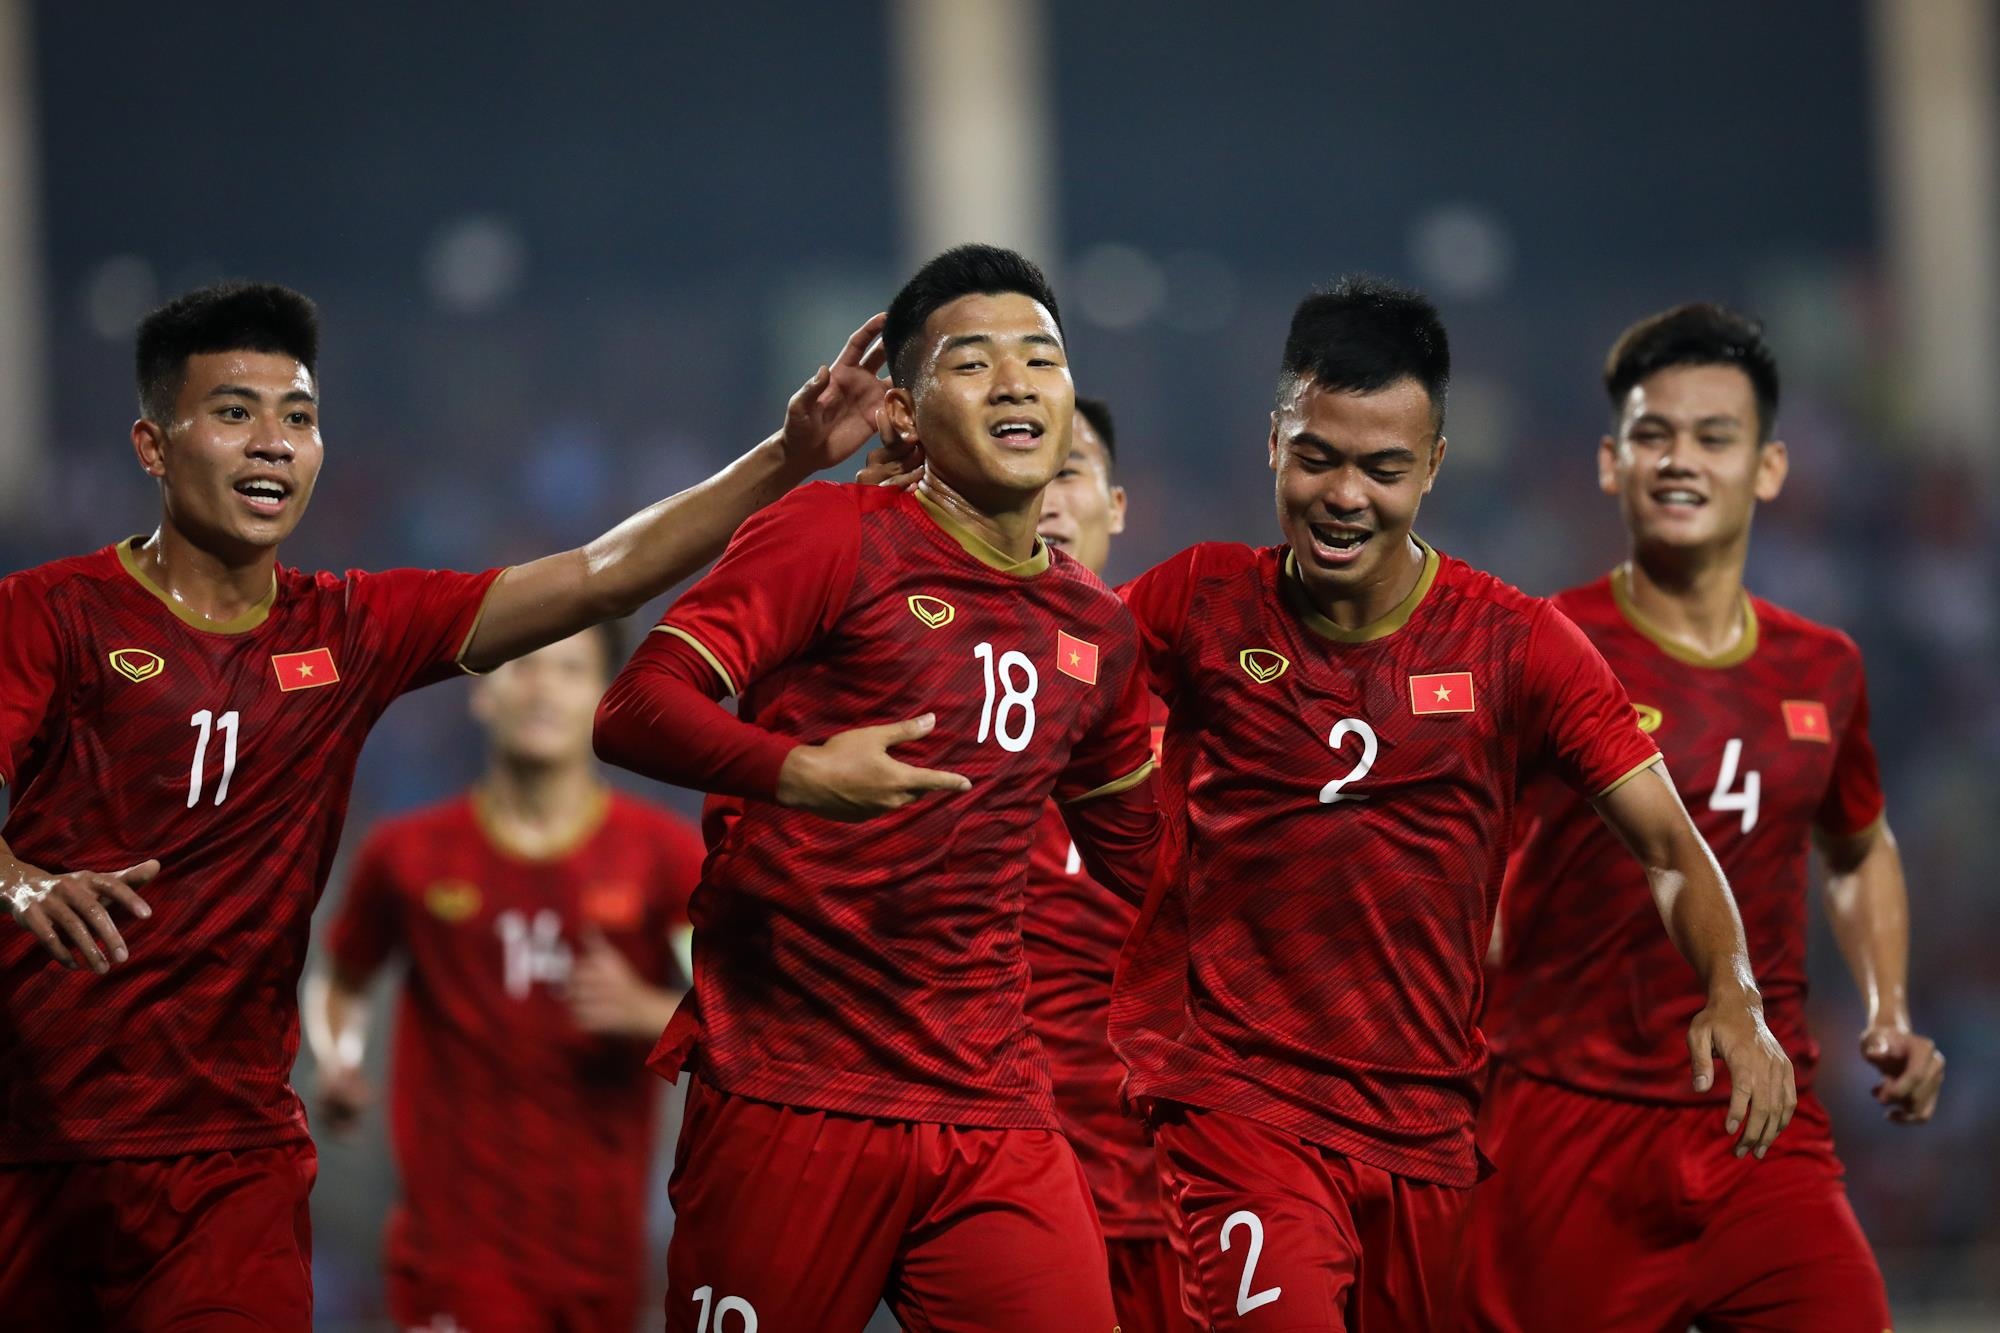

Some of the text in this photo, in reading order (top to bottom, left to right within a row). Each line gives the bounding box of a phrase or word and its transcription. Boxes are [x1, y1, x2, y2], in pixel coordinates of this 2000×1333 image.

[973, 641, 1039, 753] 18
[186, 709, 240, 808] 11
[1318, 717, 1378, 804] 2
[1709, 738, 1760, 833] 4
[1219, 1210, 1282, 1317] 2
